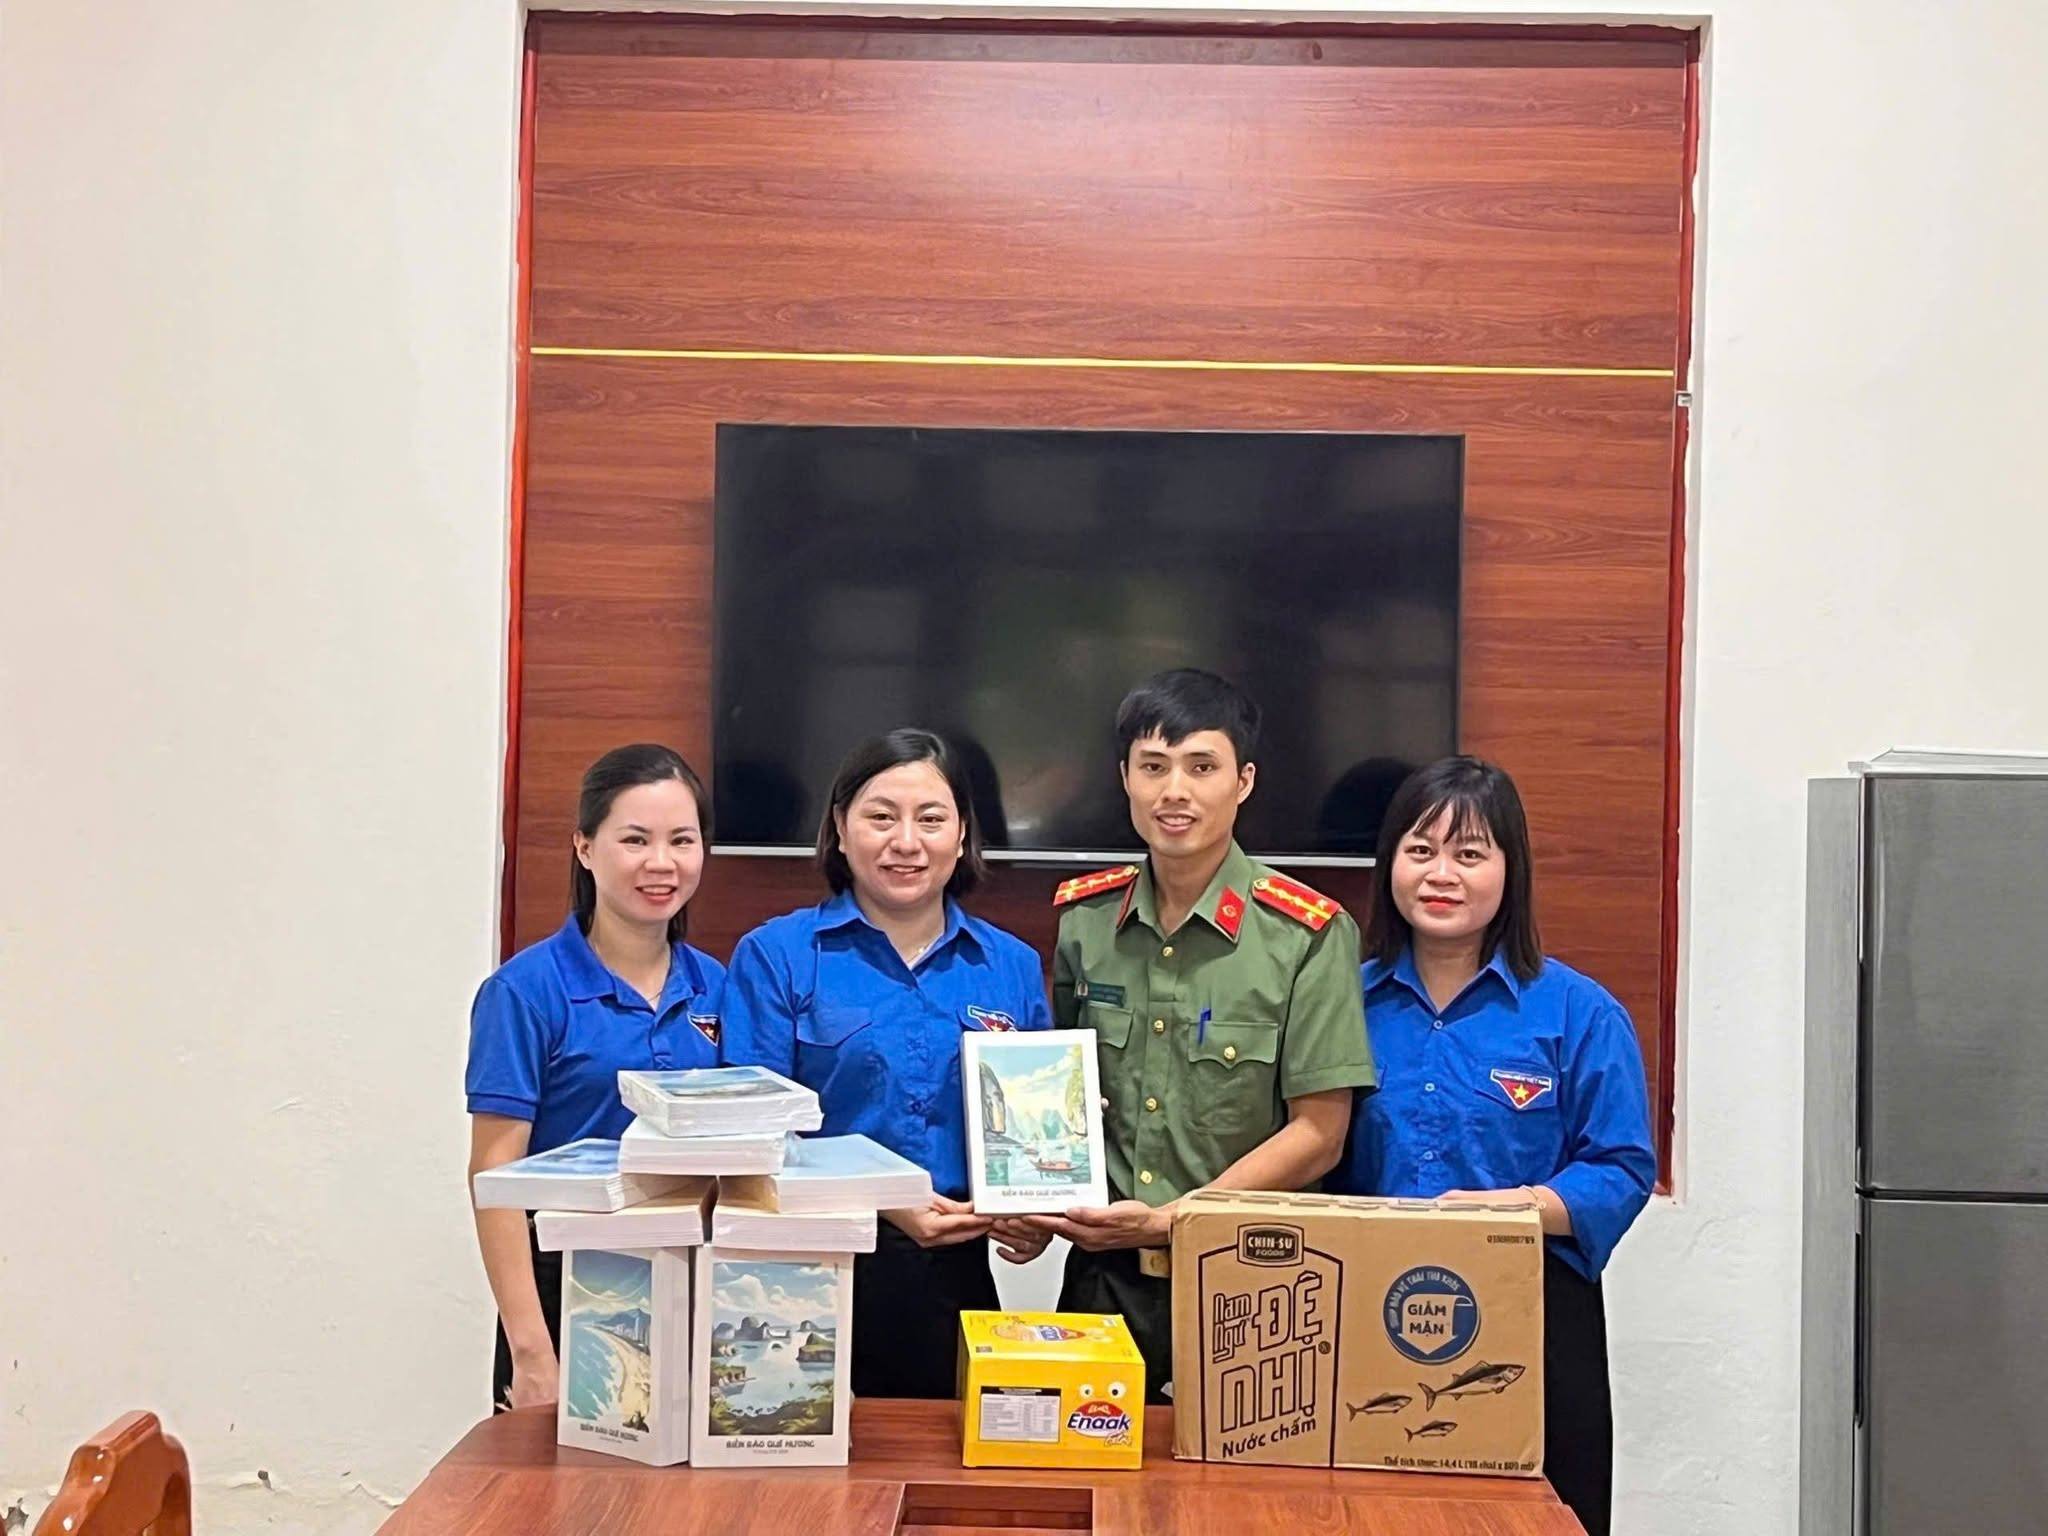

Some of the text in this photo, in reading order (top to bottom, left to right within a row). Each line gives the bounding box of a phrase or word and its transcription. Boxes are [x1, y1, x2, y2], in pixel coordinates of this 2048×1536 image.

[1407, 1300, 1447, 1316] GIẢM
[1409, 1320, 1444, 1337] MẶN
[1067, 1413, 1130, 1431] Enaak
[1222, 1416, 1316, 1458] Nước chấm
